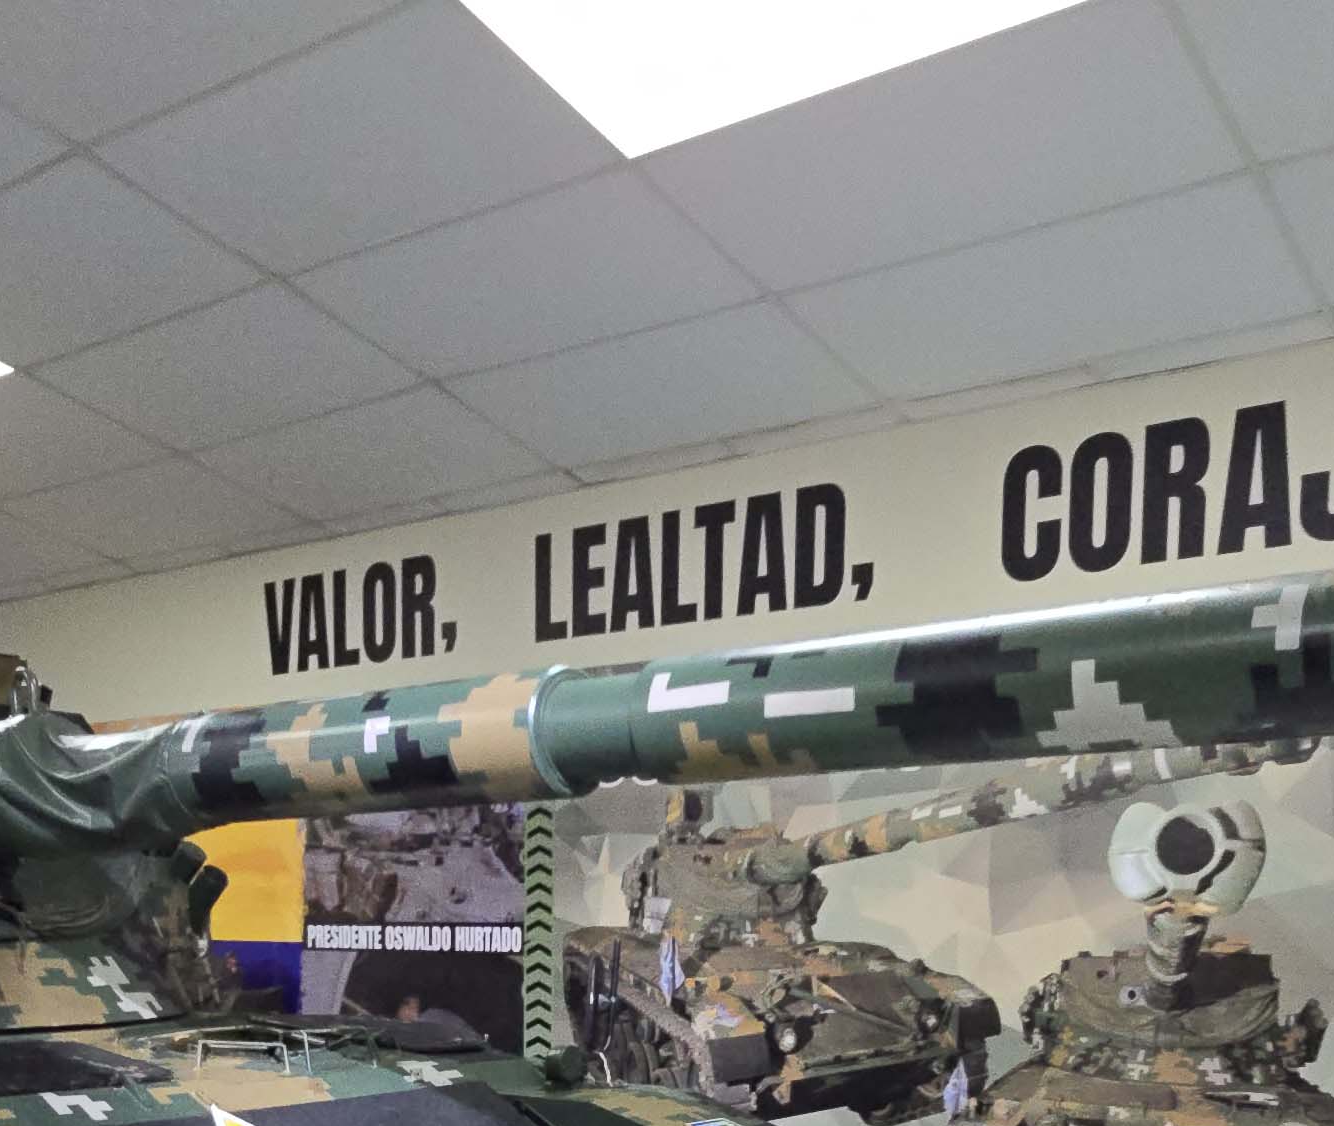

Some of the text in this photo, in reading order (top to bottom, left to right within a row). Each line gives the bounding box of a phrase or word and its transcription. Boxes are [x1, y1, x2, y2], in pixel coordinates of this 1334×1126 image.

[264, 554, 458, 676] VALOR,
[534, 482, 876, 643] LEALTAD,
[307, 924, 522, 953] PRESIDENTE OSWALDO HURTADO
